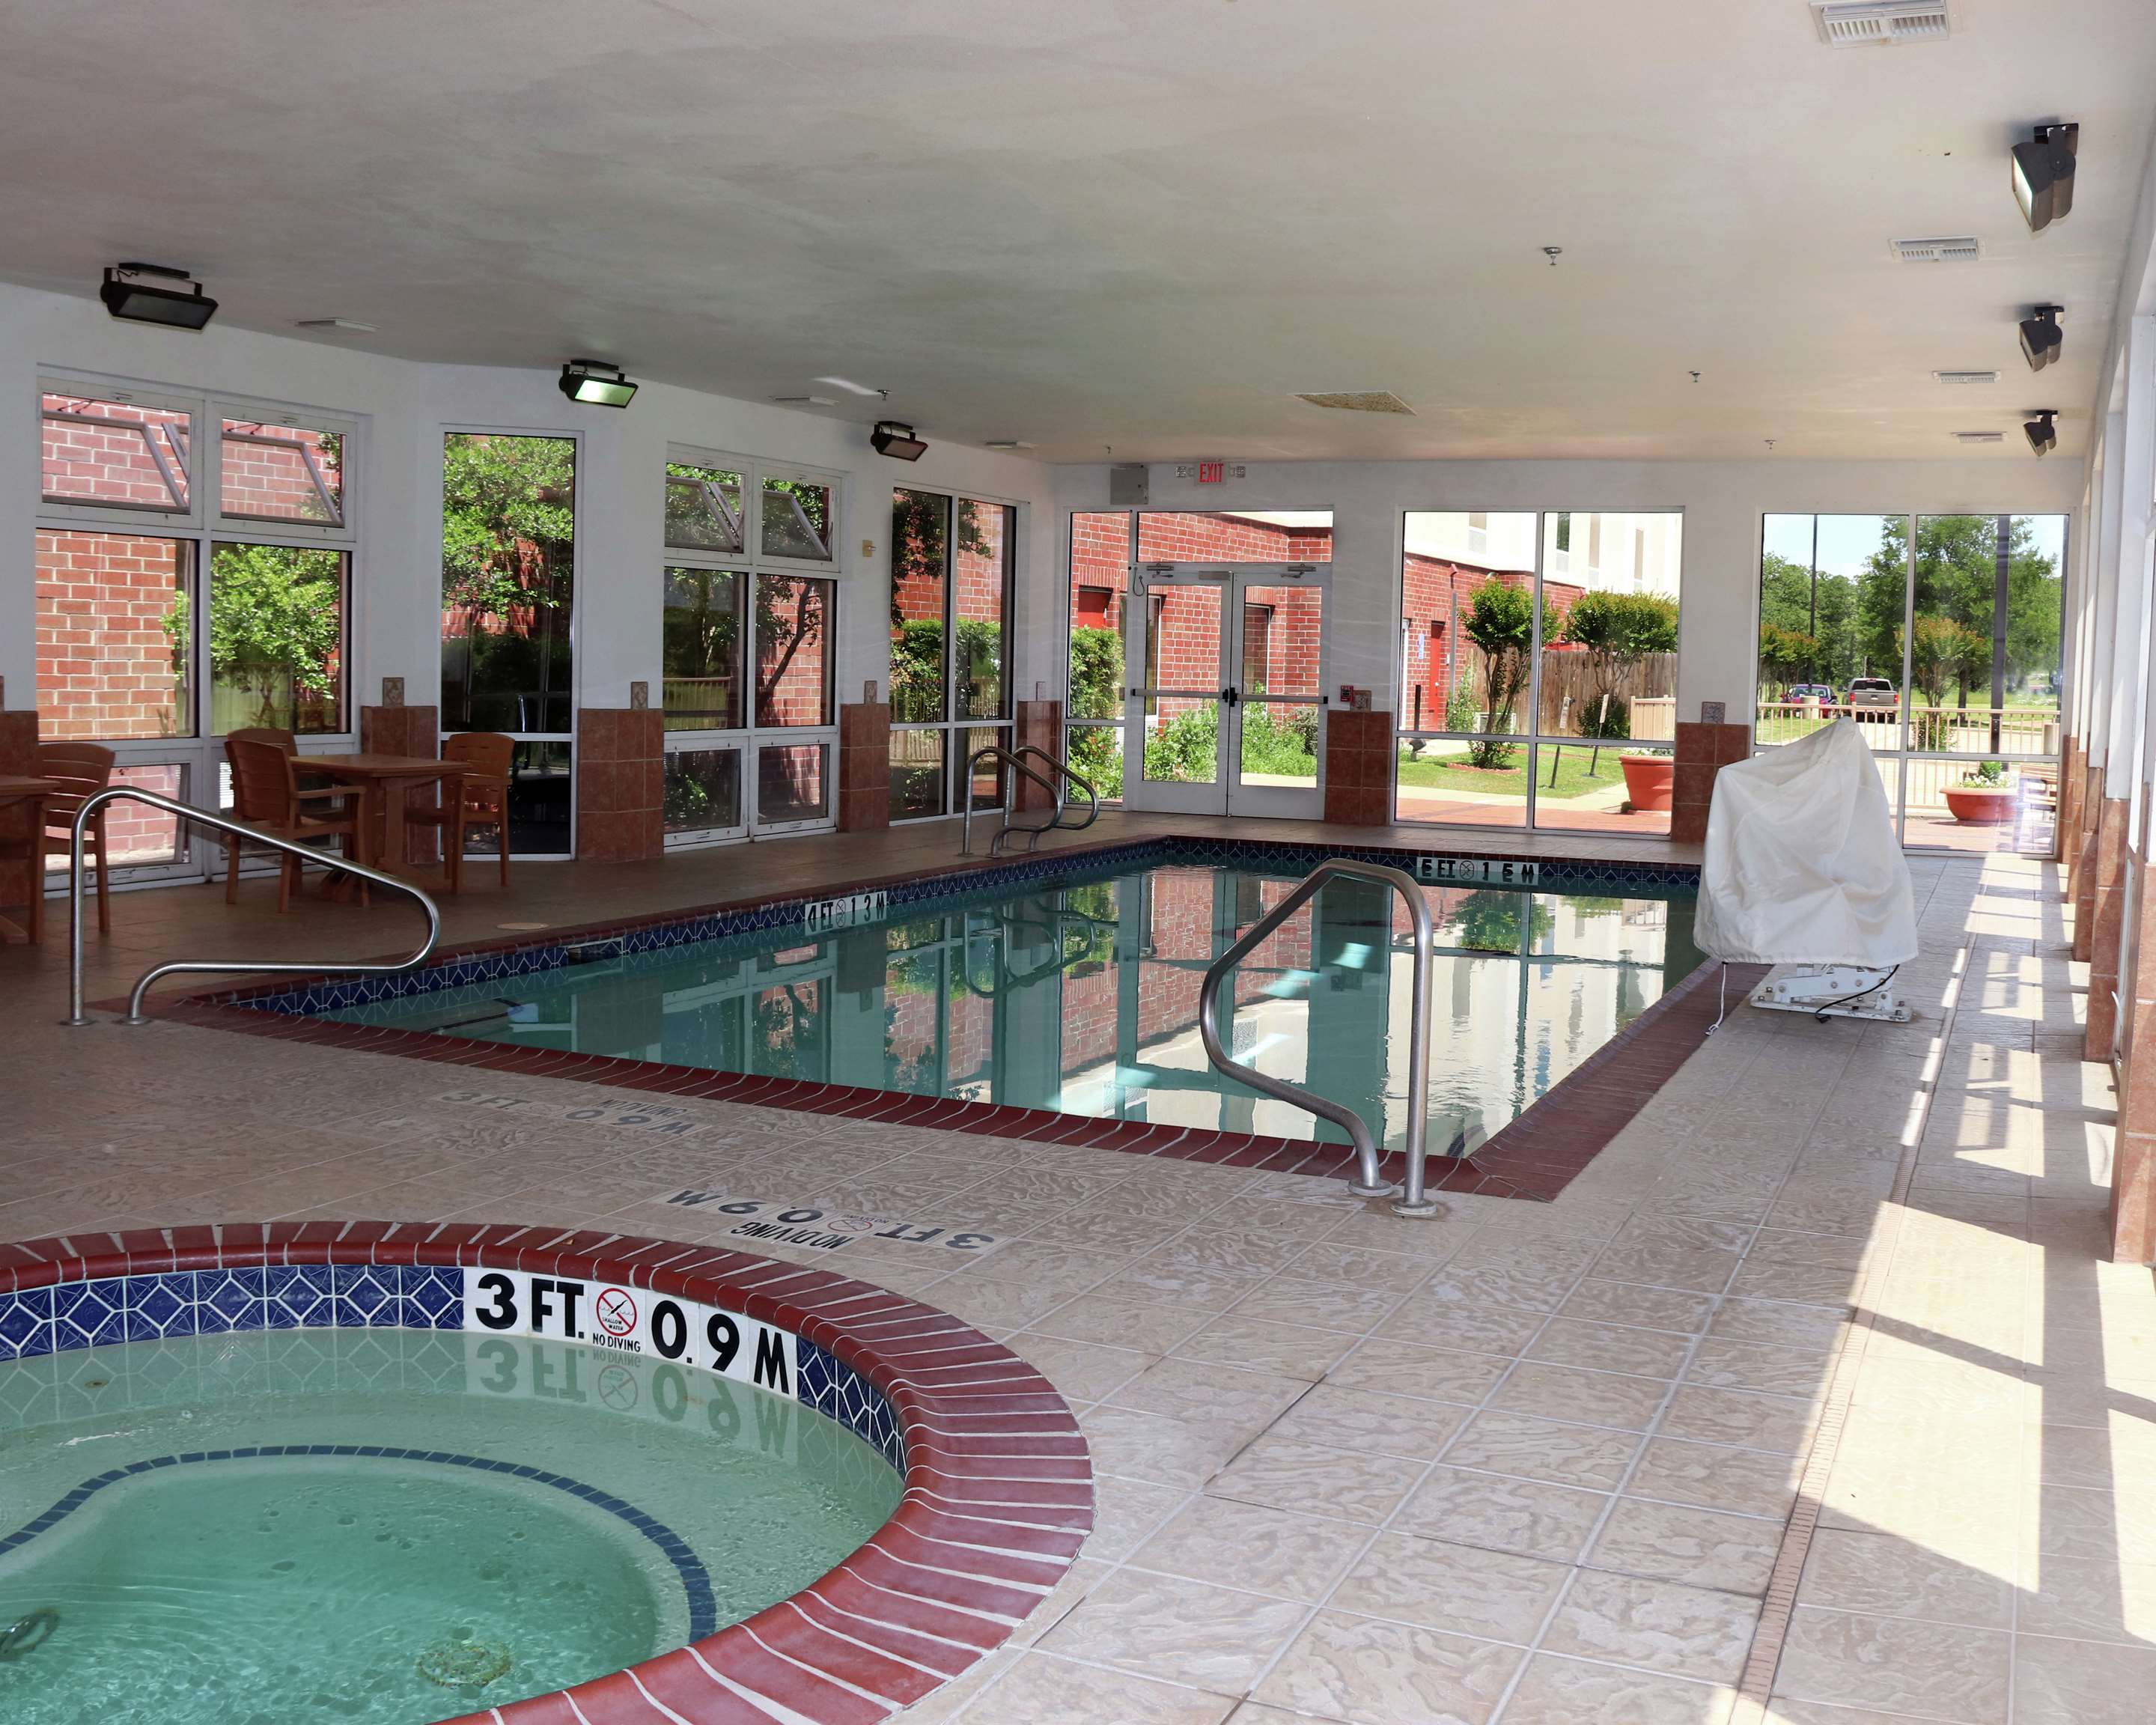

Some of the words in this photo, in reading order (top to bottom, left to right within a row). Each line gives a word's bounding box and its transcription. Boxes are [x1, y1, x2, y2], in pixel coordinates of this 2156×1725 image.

[1199, 462, 1224, 483] EXIT
[666, 1190, 720, 1207] M
[945, 1233, 995, 1250] 3
[475, 1273, 517, 1330] 3
[531, 1277, 585, 1339] FT.
[753, 1327, 790, 1395] M
[593, 1333, 606, 1346] NO
[607, 1336, 641, 1352] DIVING
